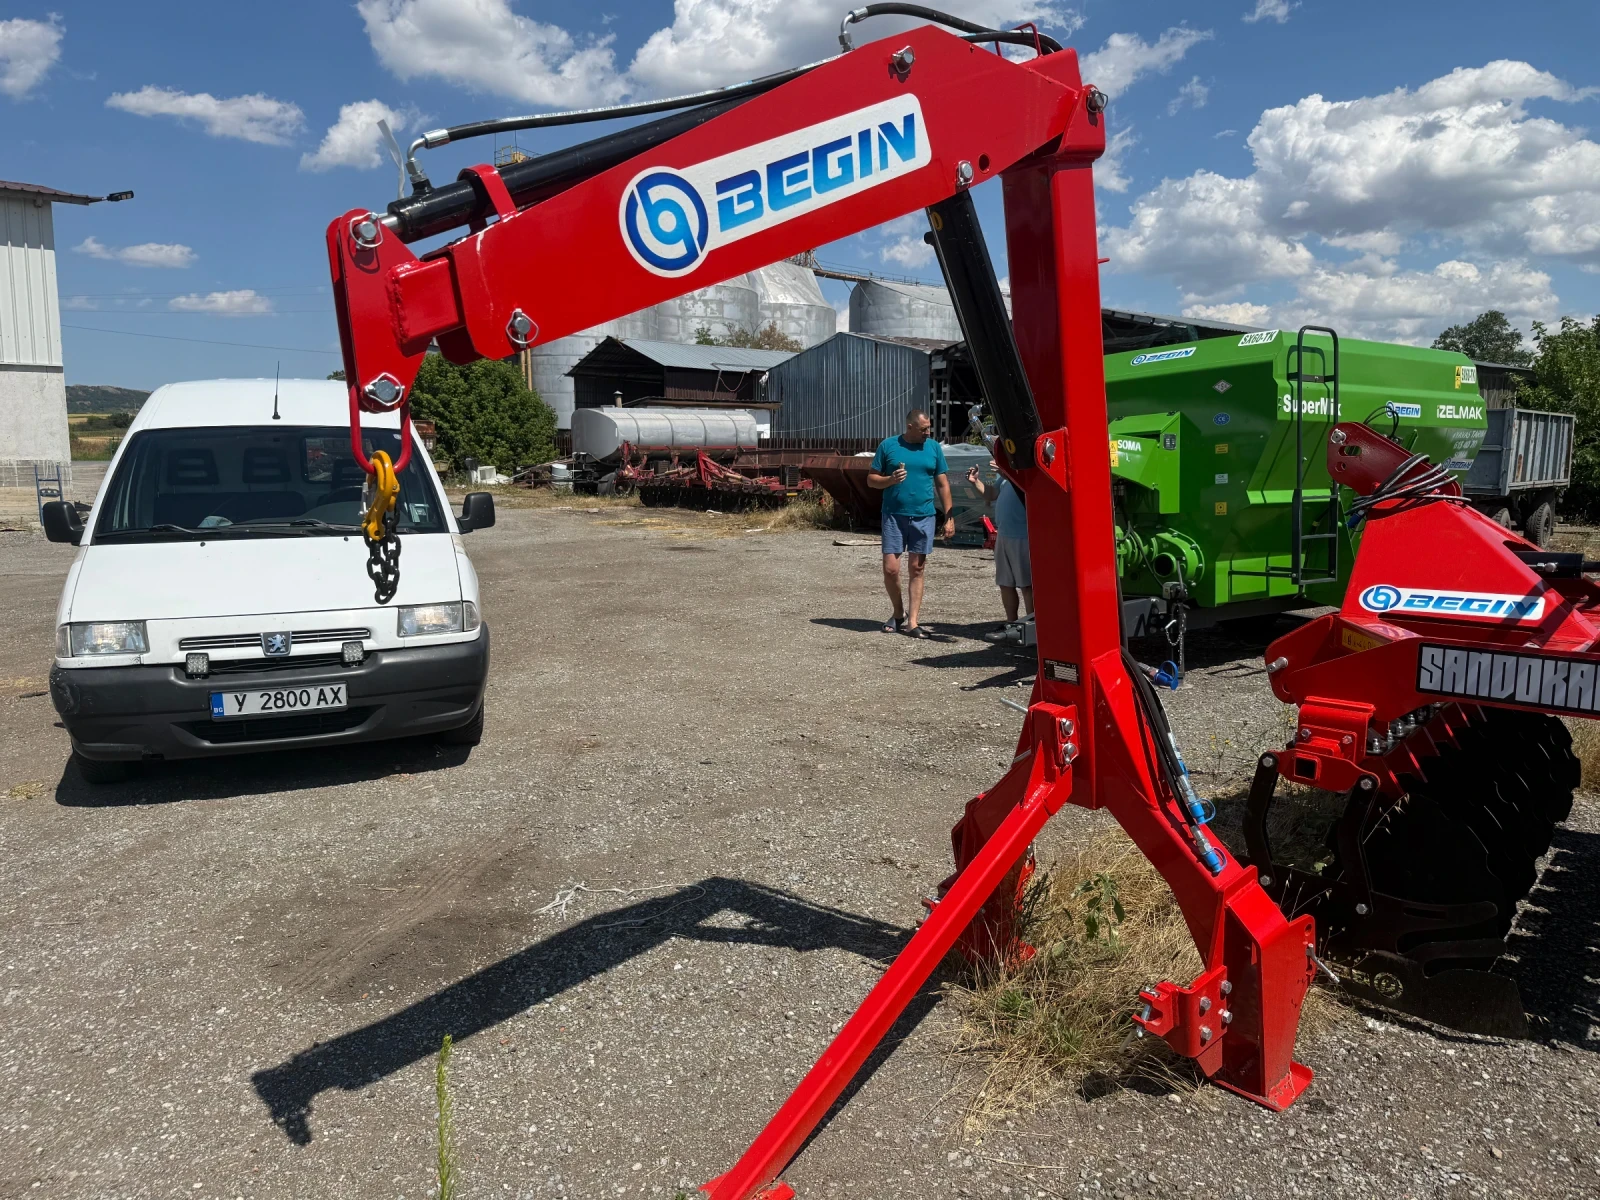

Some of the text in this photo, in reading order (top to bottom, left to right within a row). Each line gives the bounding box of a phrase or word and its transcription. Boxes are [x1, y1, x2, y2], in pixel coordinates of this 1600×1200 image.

[715, 112, 917, 233] BEGIN
[1146, 349, 1194, 361] BEGIN
[1395, 406, 1420, 416] BEGIN
[1117, 439, 1142, 452] SOMA
[1448, 461, 1473, 469] BEGIN
[1402, 594, 1539, 616] BEGIN
[260, 689, 311, 710] 2800
[316, 686, 343, 706] AX
